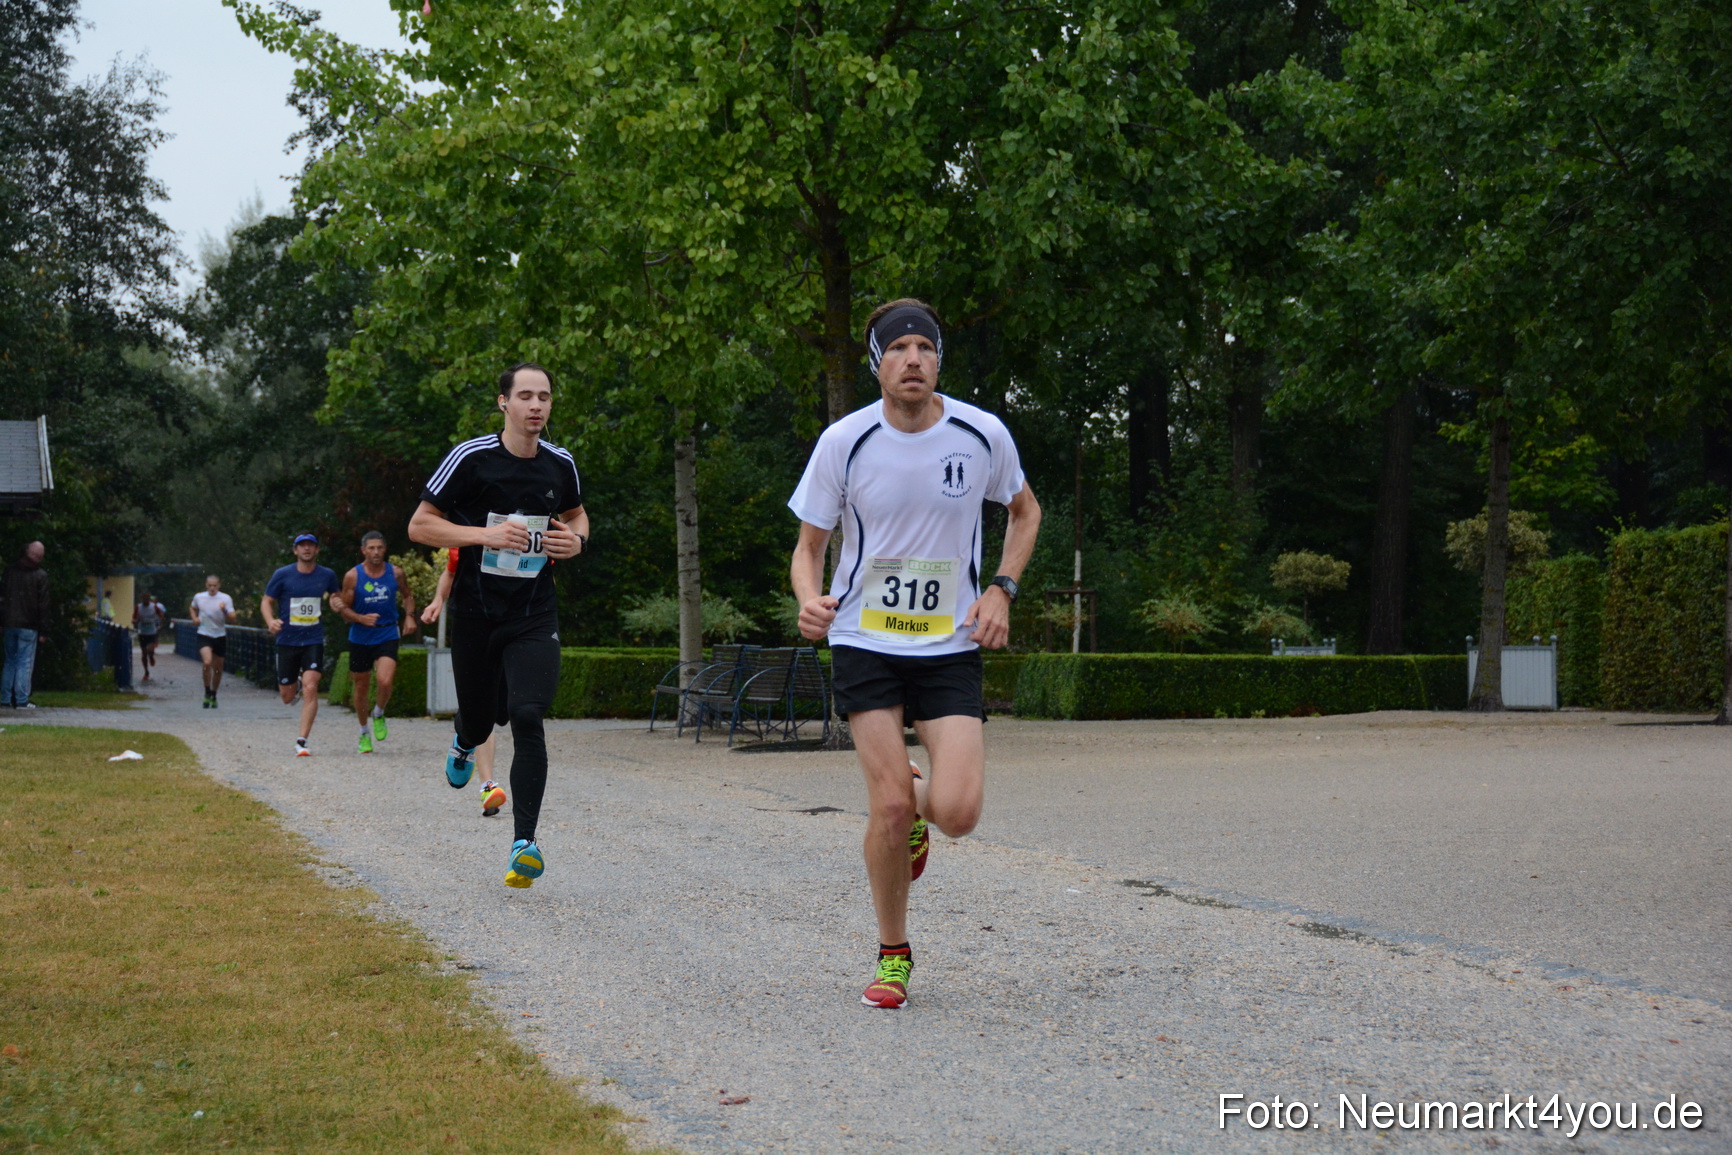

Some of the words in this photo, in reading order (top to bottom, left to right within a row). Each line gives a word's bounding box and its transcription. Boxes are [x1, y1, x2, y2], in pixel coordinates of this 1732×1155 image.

[940, 452, 972, 463] Lauftreff
[907, 559, 952, 573] BOCK
[882, 575, 940, 611] 318
[300, 604, 314, 616] 99
[885, 616, 929, 632] Markus
